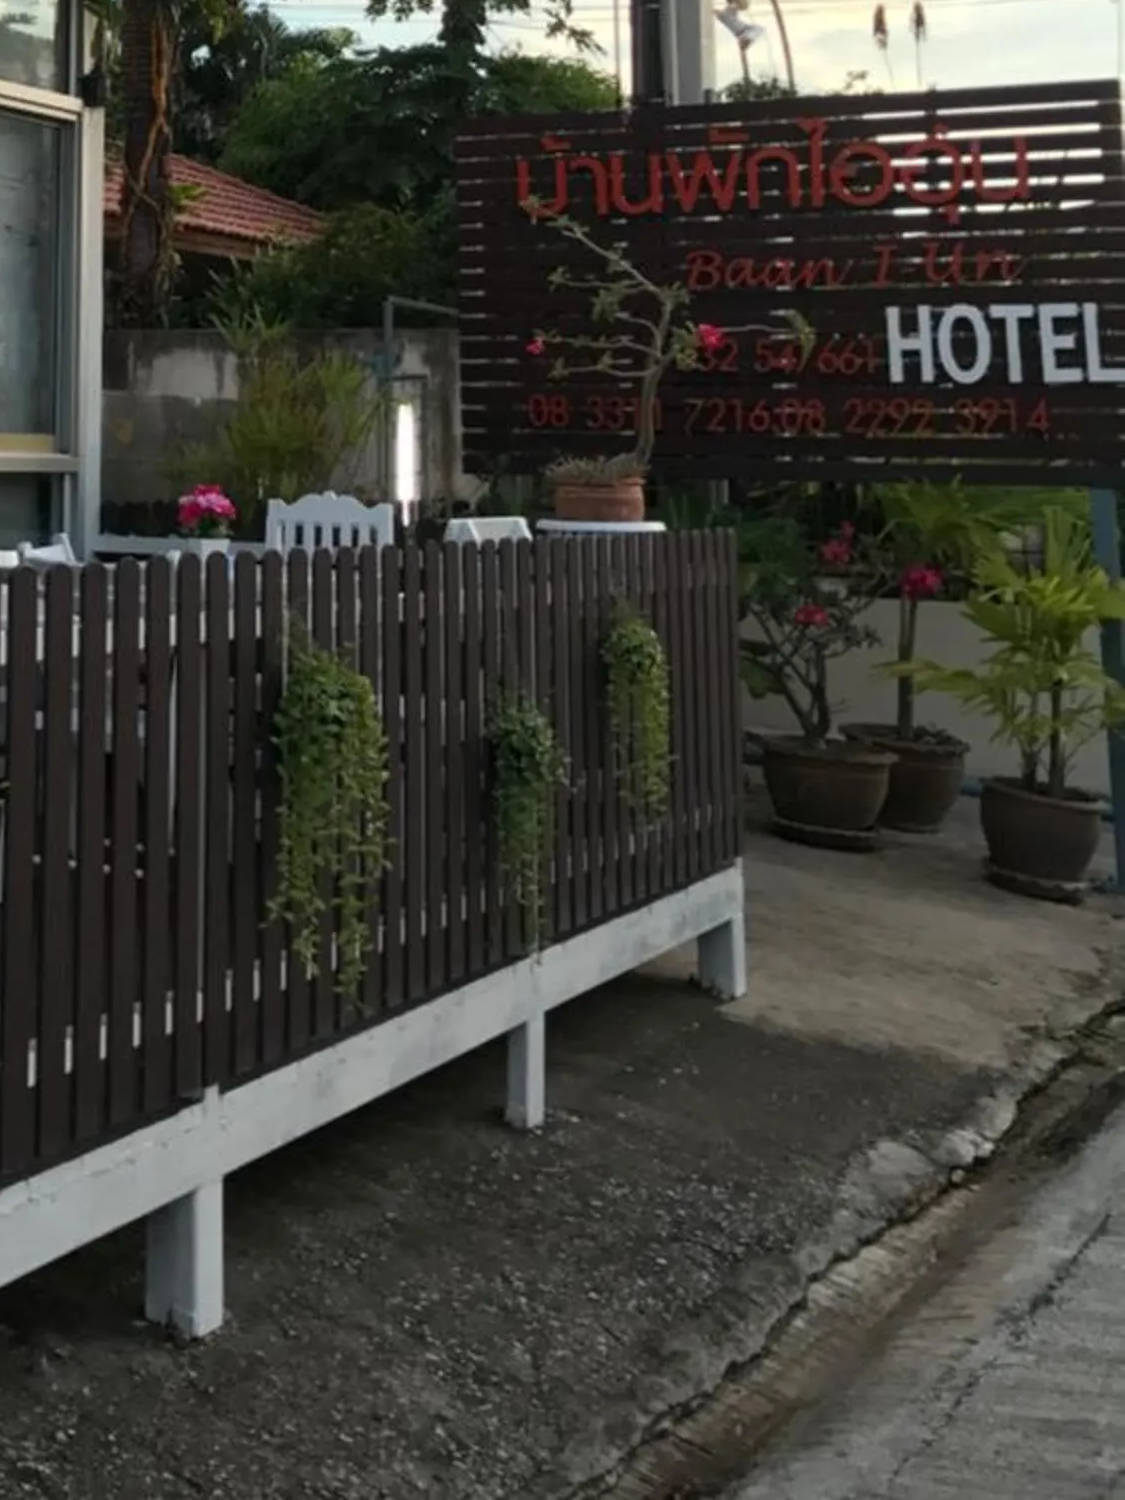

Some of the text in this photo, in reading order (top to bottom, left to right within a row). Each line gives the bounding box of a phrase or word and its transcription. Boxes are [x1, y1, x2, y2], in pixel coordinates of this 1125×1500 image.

[686, 249, 853, 291] Baan
[885, 301, 1124, 384] HOTEL
[526, 393, 570, 428] 08
